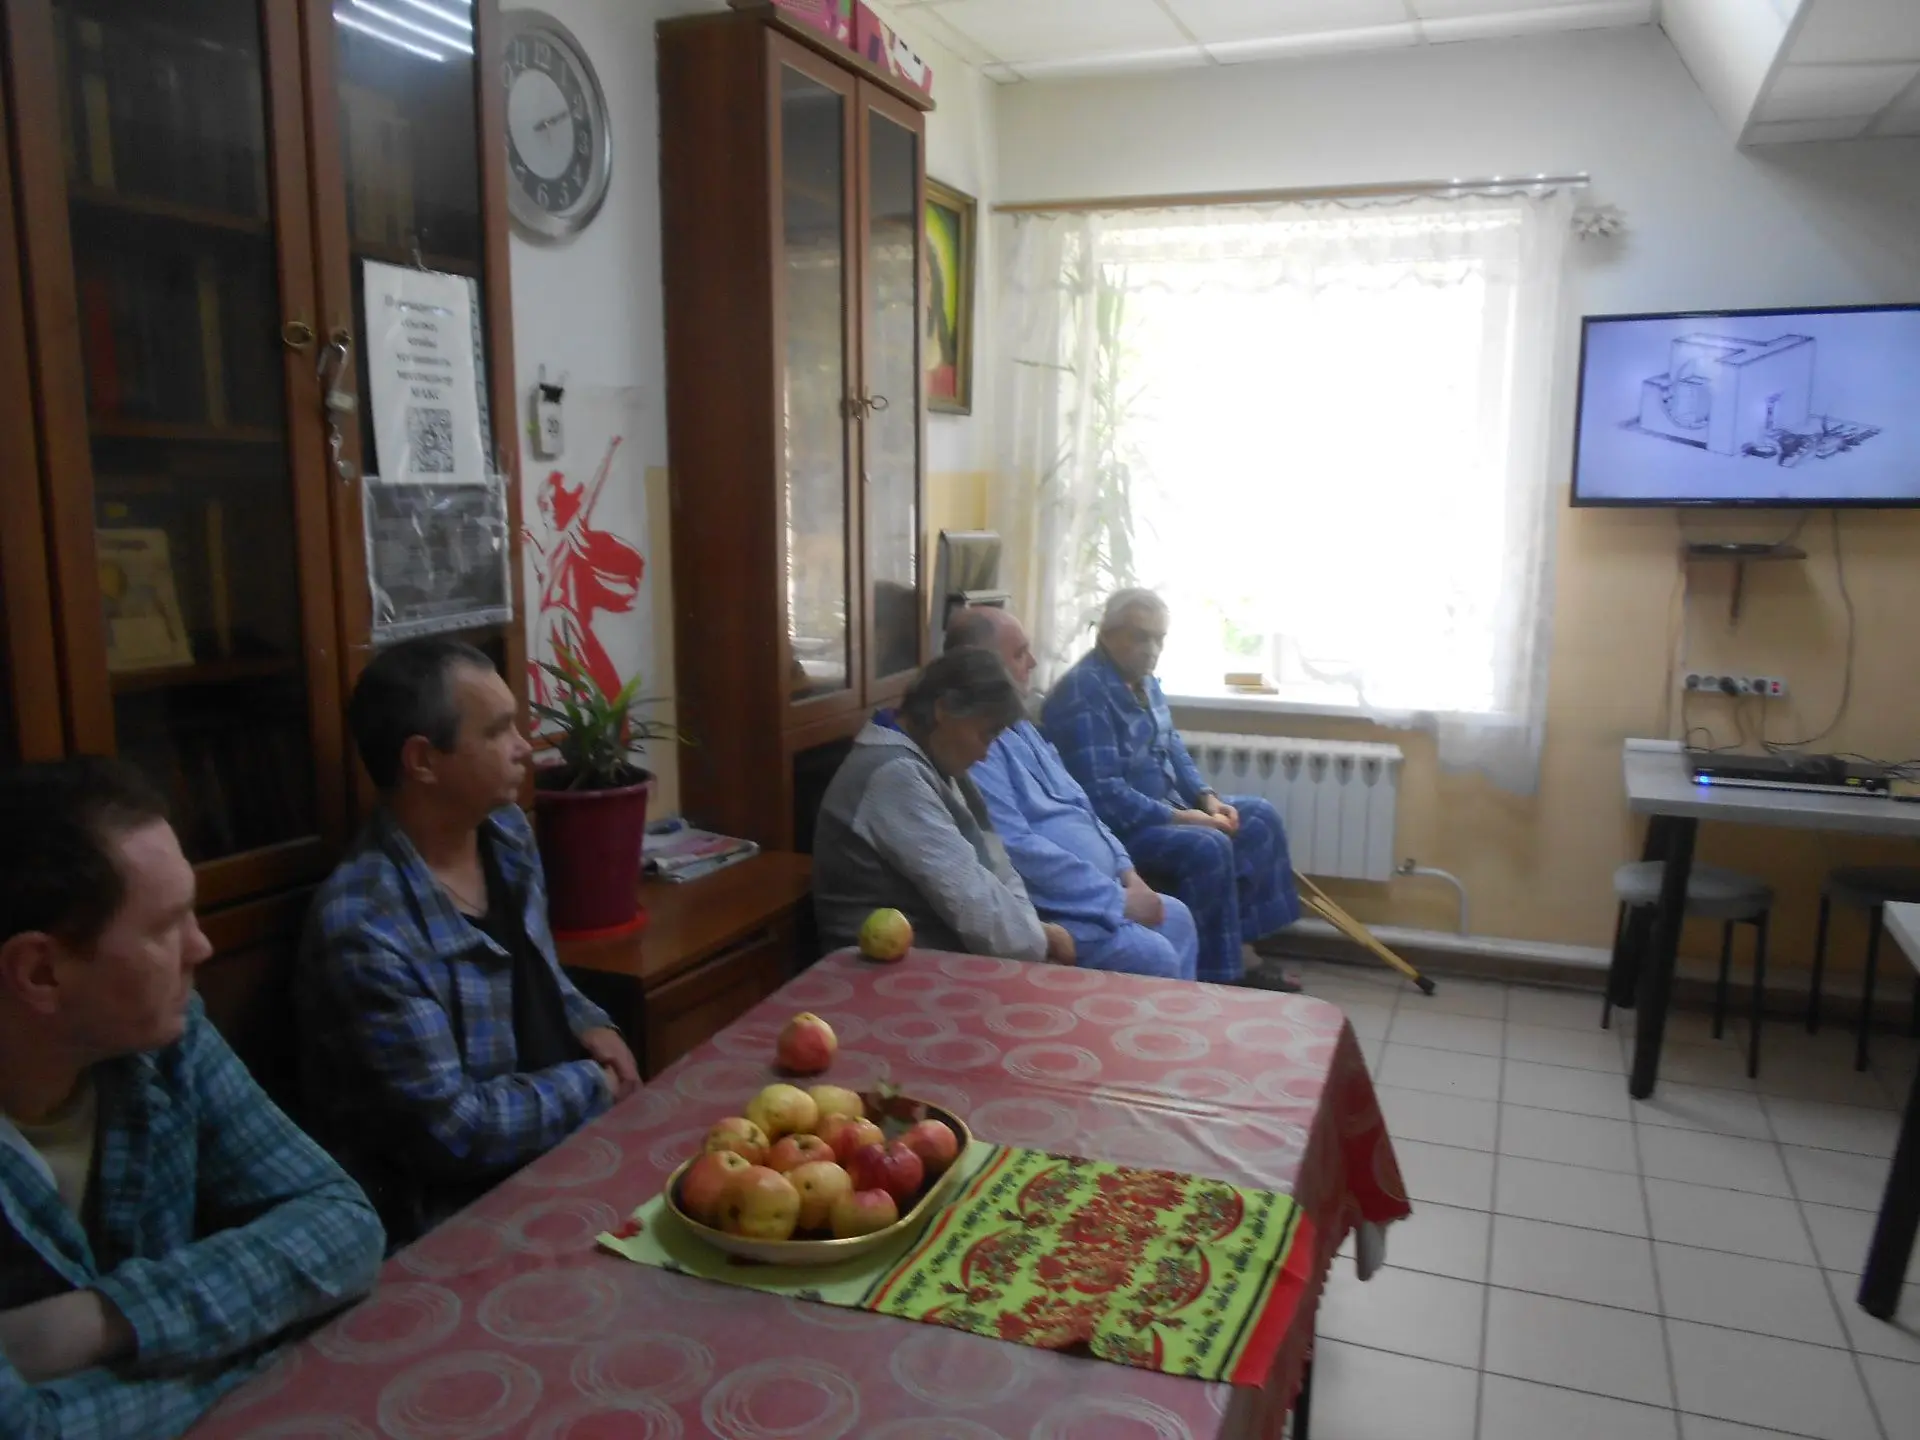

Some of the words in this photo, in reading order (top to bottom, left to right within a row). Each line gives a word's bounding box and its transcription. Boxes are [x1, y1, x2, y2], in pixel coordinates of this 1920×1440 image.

[533, 41, 553, 71] 12
[572, 93, 585, 121] 2
[577, 131, 590, 155] 3
[536, 182, 550, 208] 6
